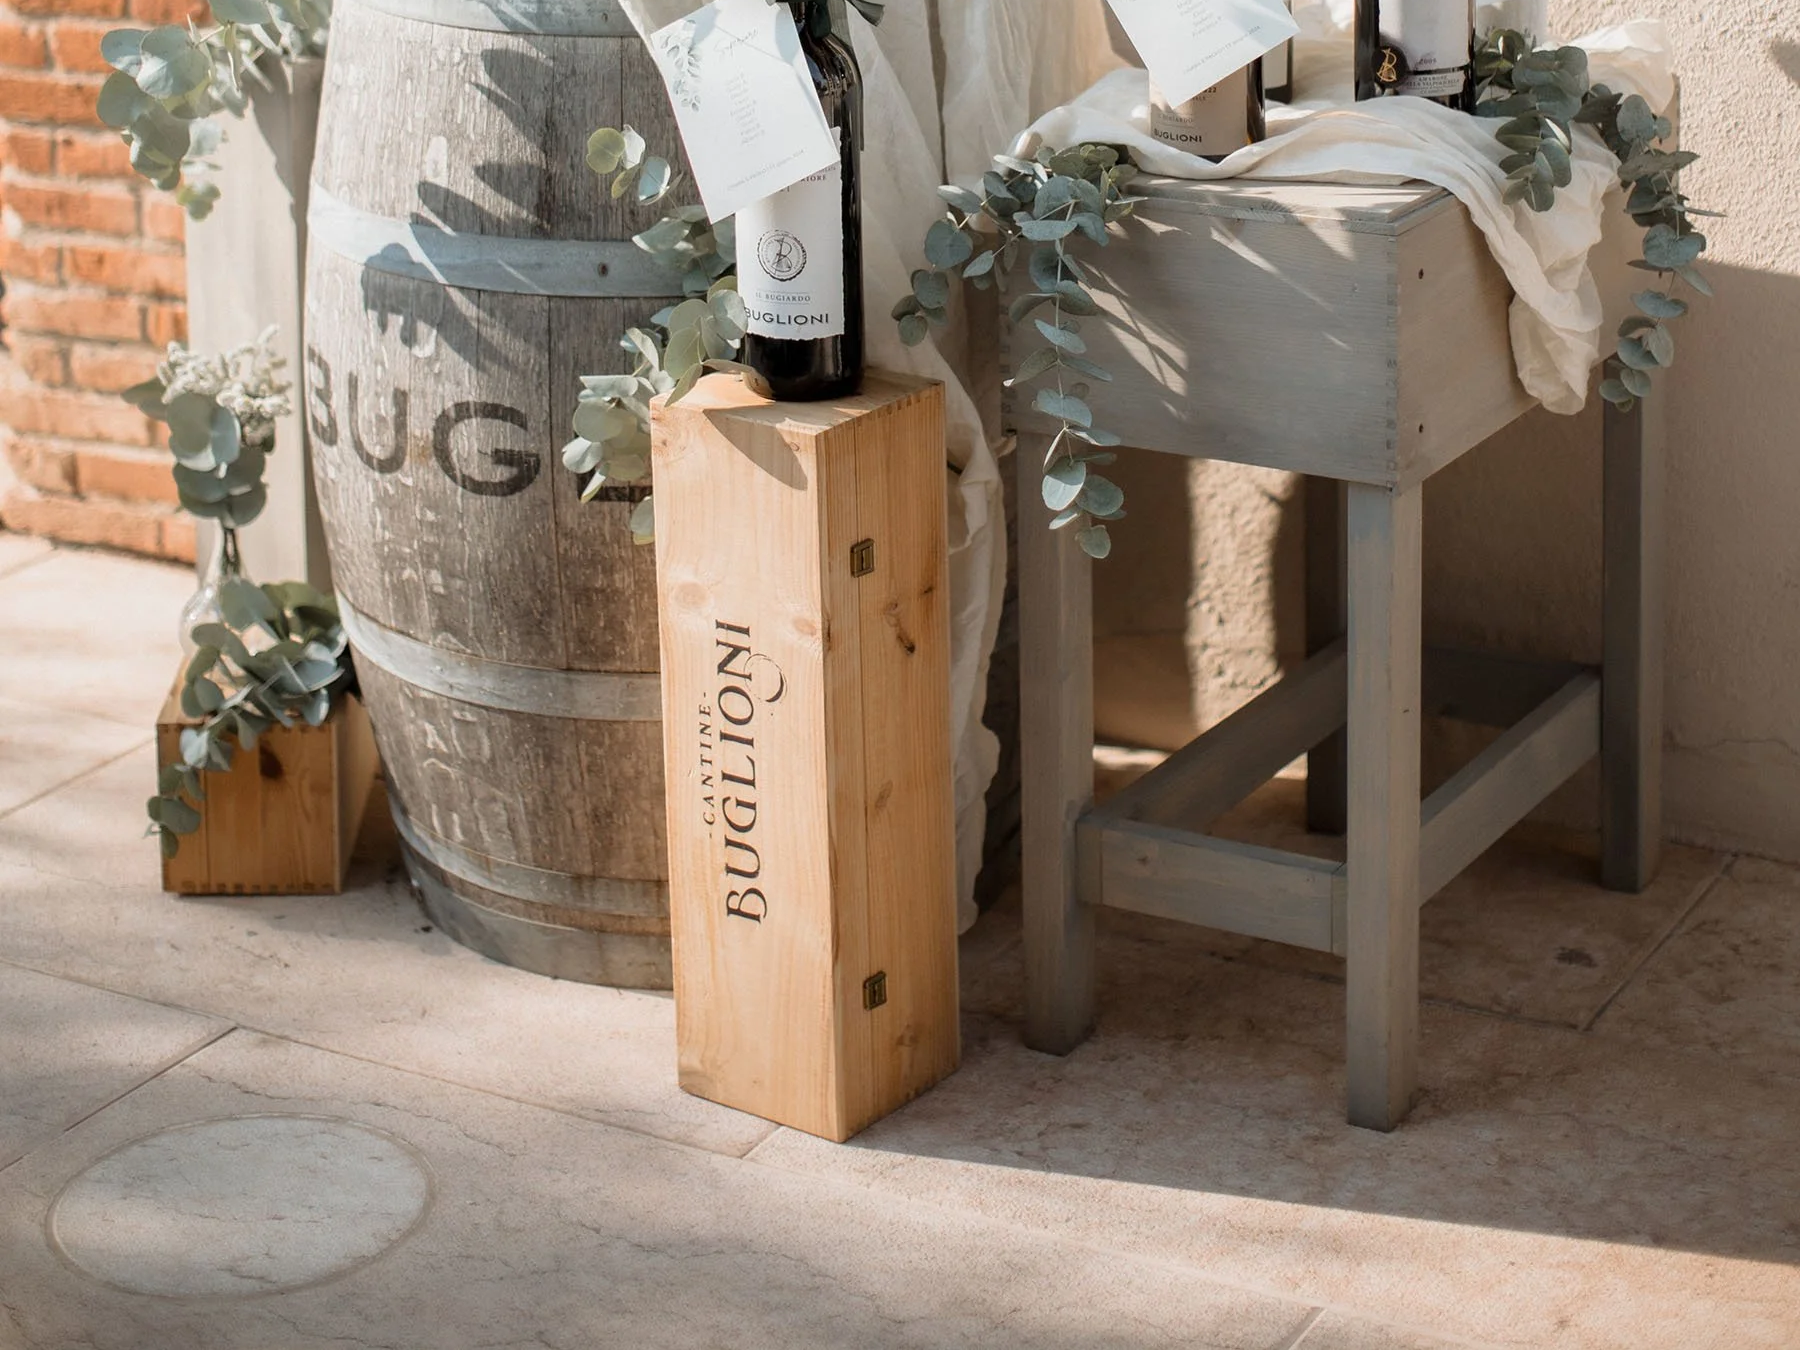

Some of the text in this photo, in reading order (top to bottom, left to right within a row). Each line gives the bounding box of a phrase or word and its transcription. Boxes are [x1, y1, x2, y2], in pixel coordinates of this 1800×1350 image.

[765, 294, 811, 302] BUGIARDO
[744, 307, 829, 325] BUGLIONI
[715, 618, 769, 925] BUGLIONI
